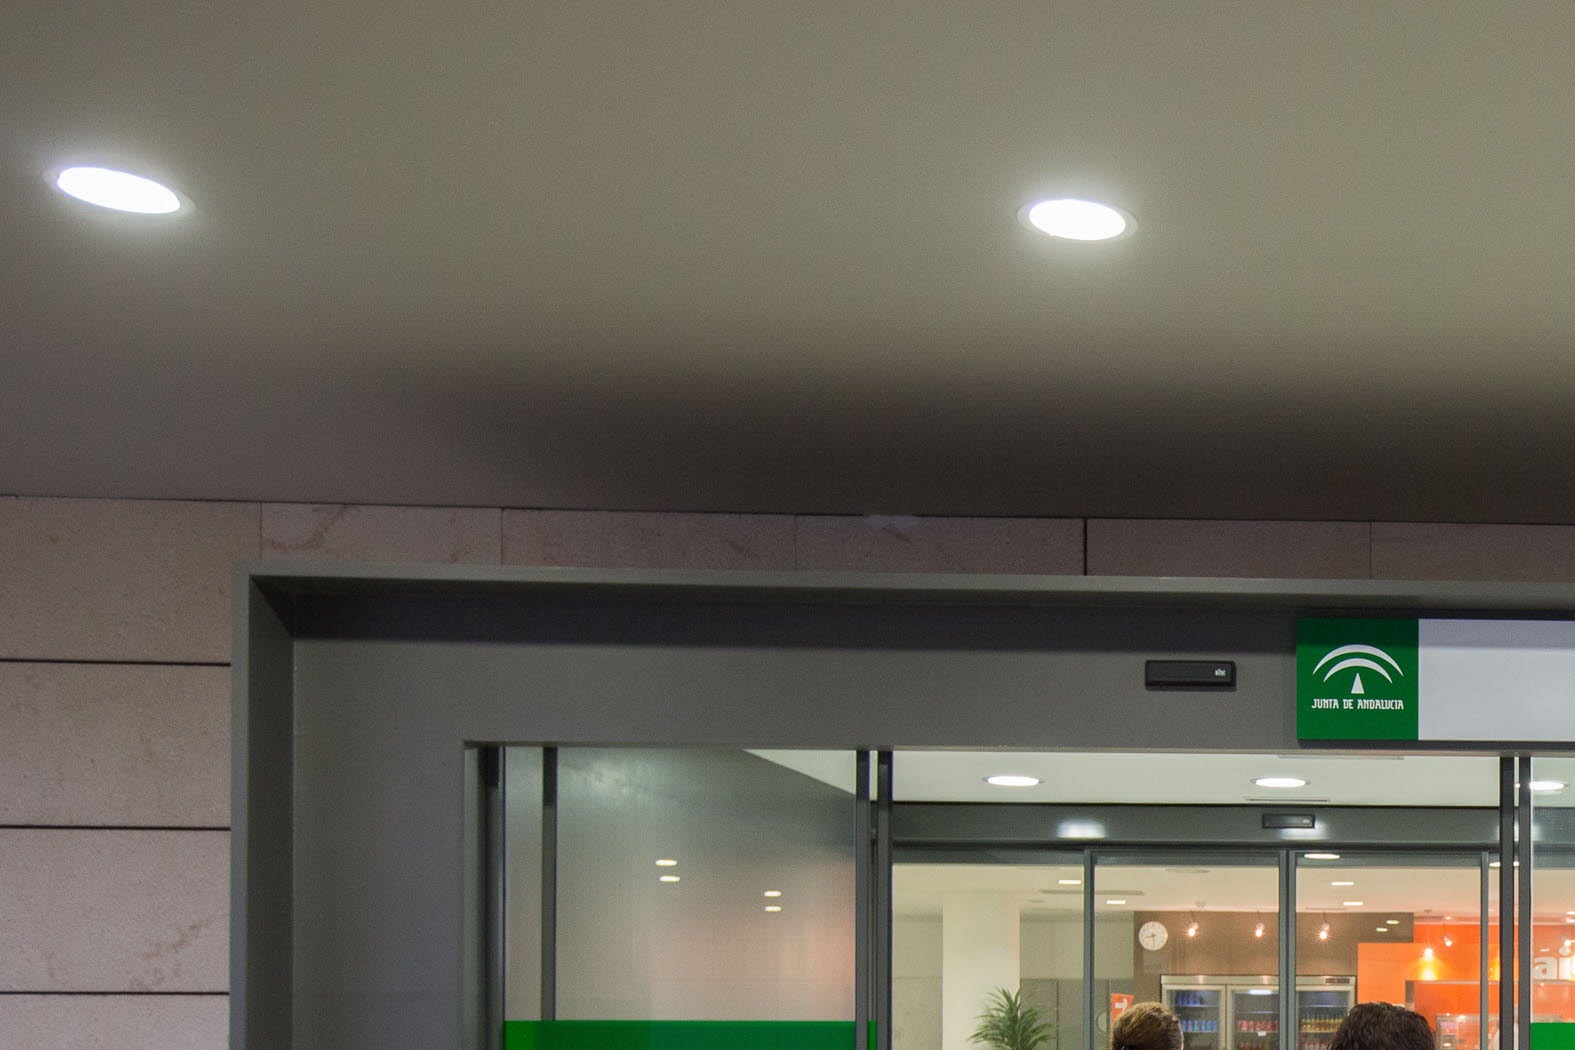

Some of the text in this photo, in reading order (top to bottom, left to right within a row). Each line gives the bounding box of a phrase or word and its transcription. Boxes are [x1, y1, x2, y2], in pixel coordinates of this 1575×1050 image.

[1311, 698, 1404, 710] JUNTA DE ANDALUCIA
